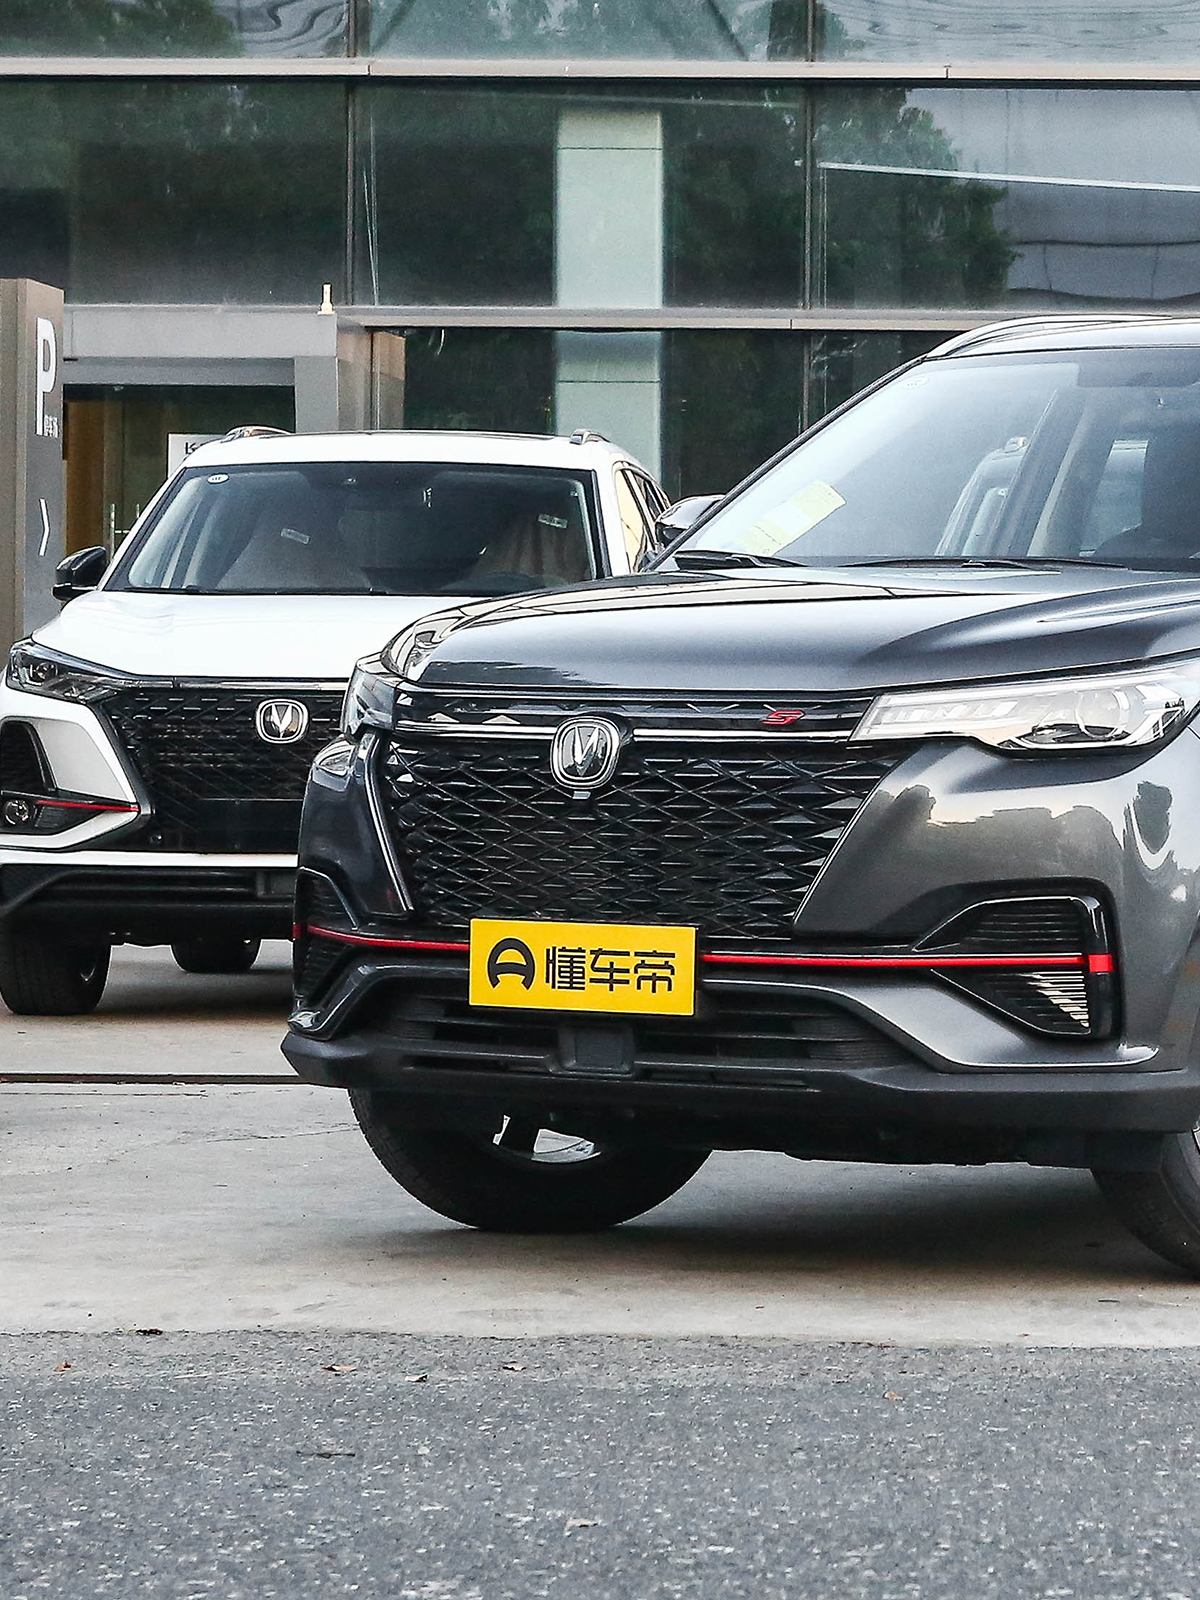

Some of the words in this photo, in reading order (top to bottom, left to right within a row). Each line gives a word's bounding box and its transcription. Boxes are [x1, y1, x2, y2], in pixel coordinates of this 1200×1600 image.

[36, 317, 57, 435] P
[544, 946, 676, 993] 懂车帝
